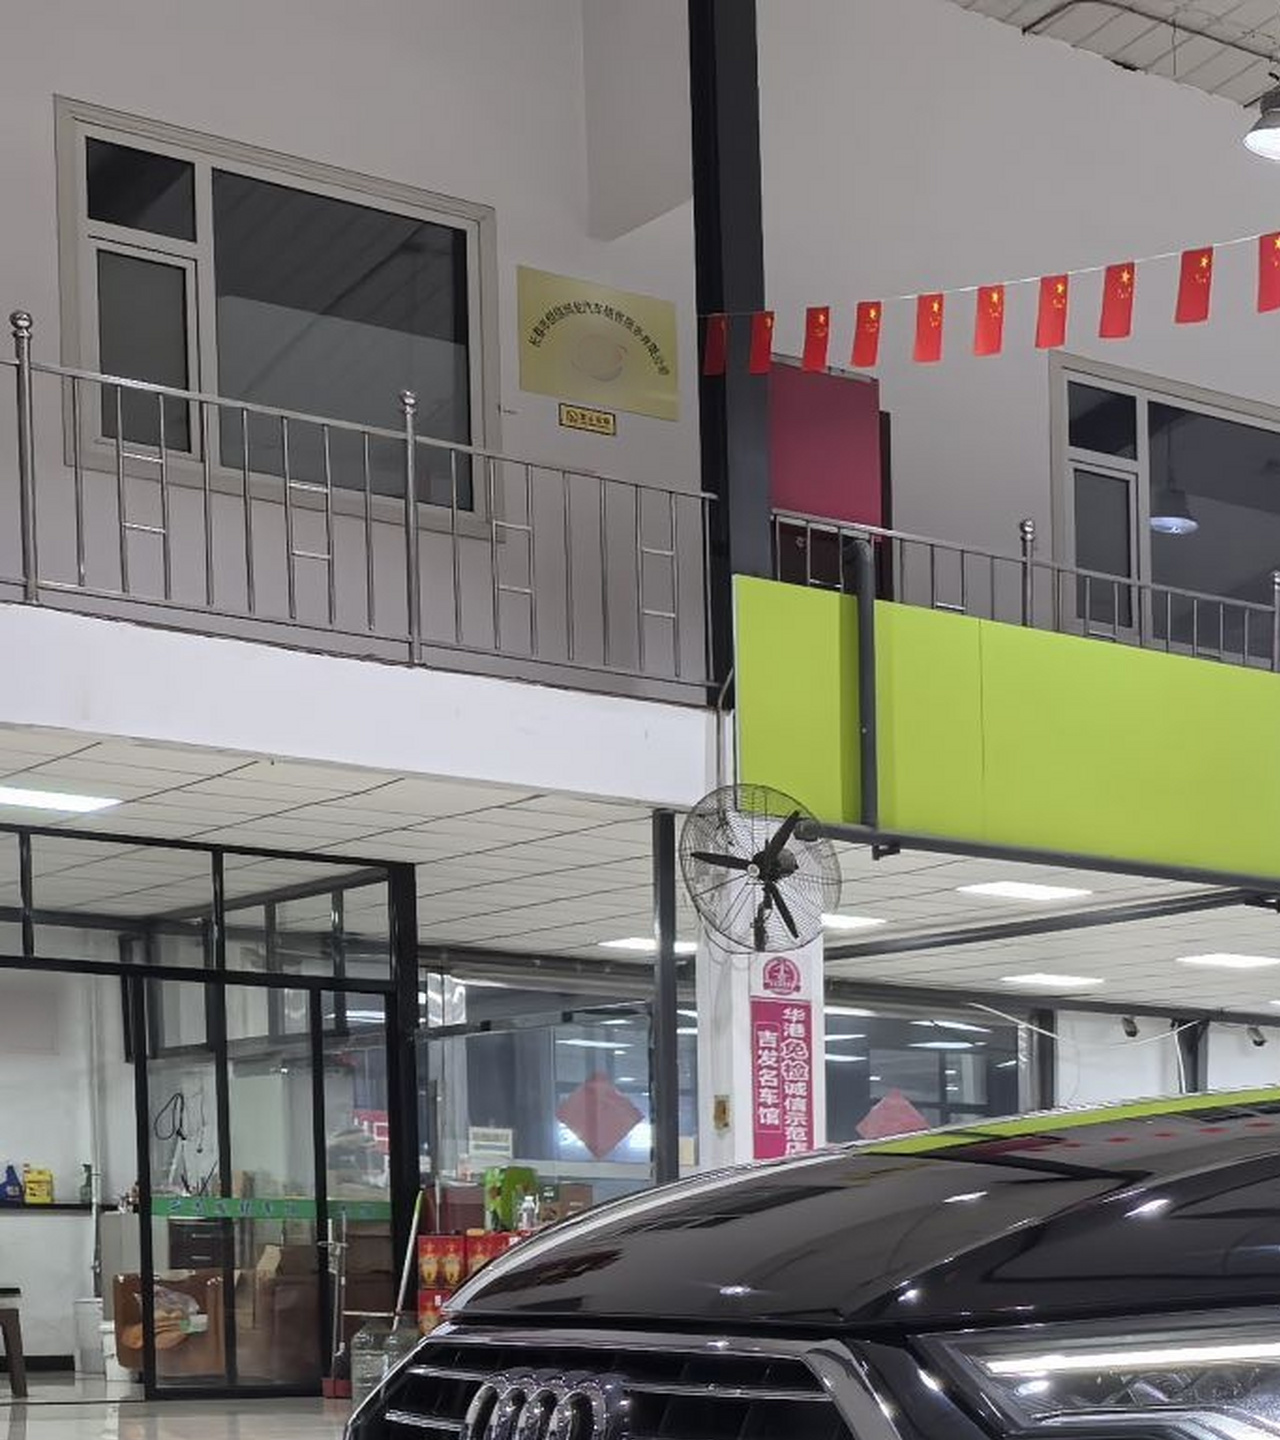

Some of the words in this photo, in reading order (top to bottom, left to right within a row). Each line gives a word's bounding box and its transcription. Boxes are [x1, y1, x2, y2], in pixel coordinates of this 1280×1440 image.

[757, 1029, 780, 1126] 吉发名车馆
